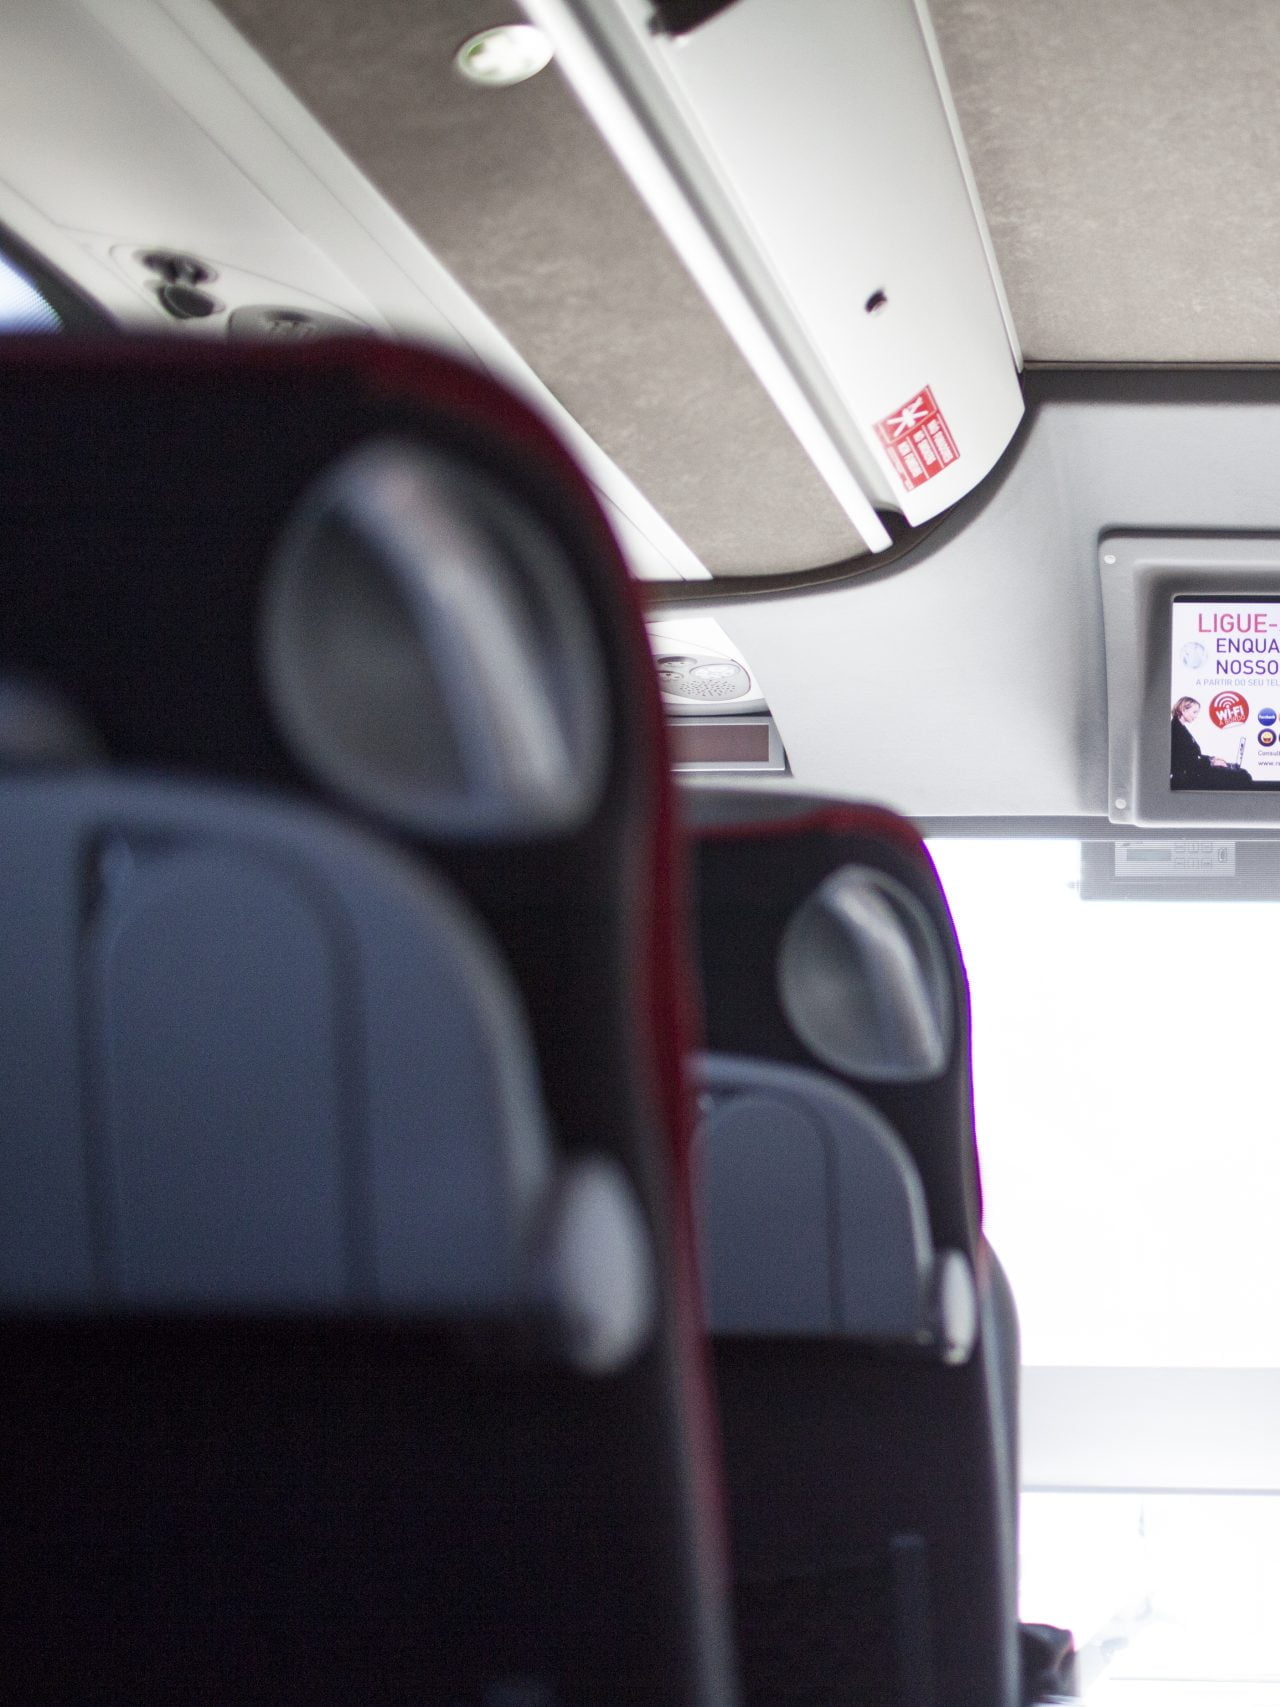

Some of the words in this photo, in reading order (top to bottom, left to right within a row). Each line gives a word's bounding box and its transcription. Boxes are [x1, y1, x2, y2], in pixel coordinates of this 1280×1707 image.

[1196, 678, 1201, 686] A
[1203, 678, 1232, 686] PARTIR
[1234, 678, 1246, 686] DO
[1248, 678, 1264, 687] SEU
